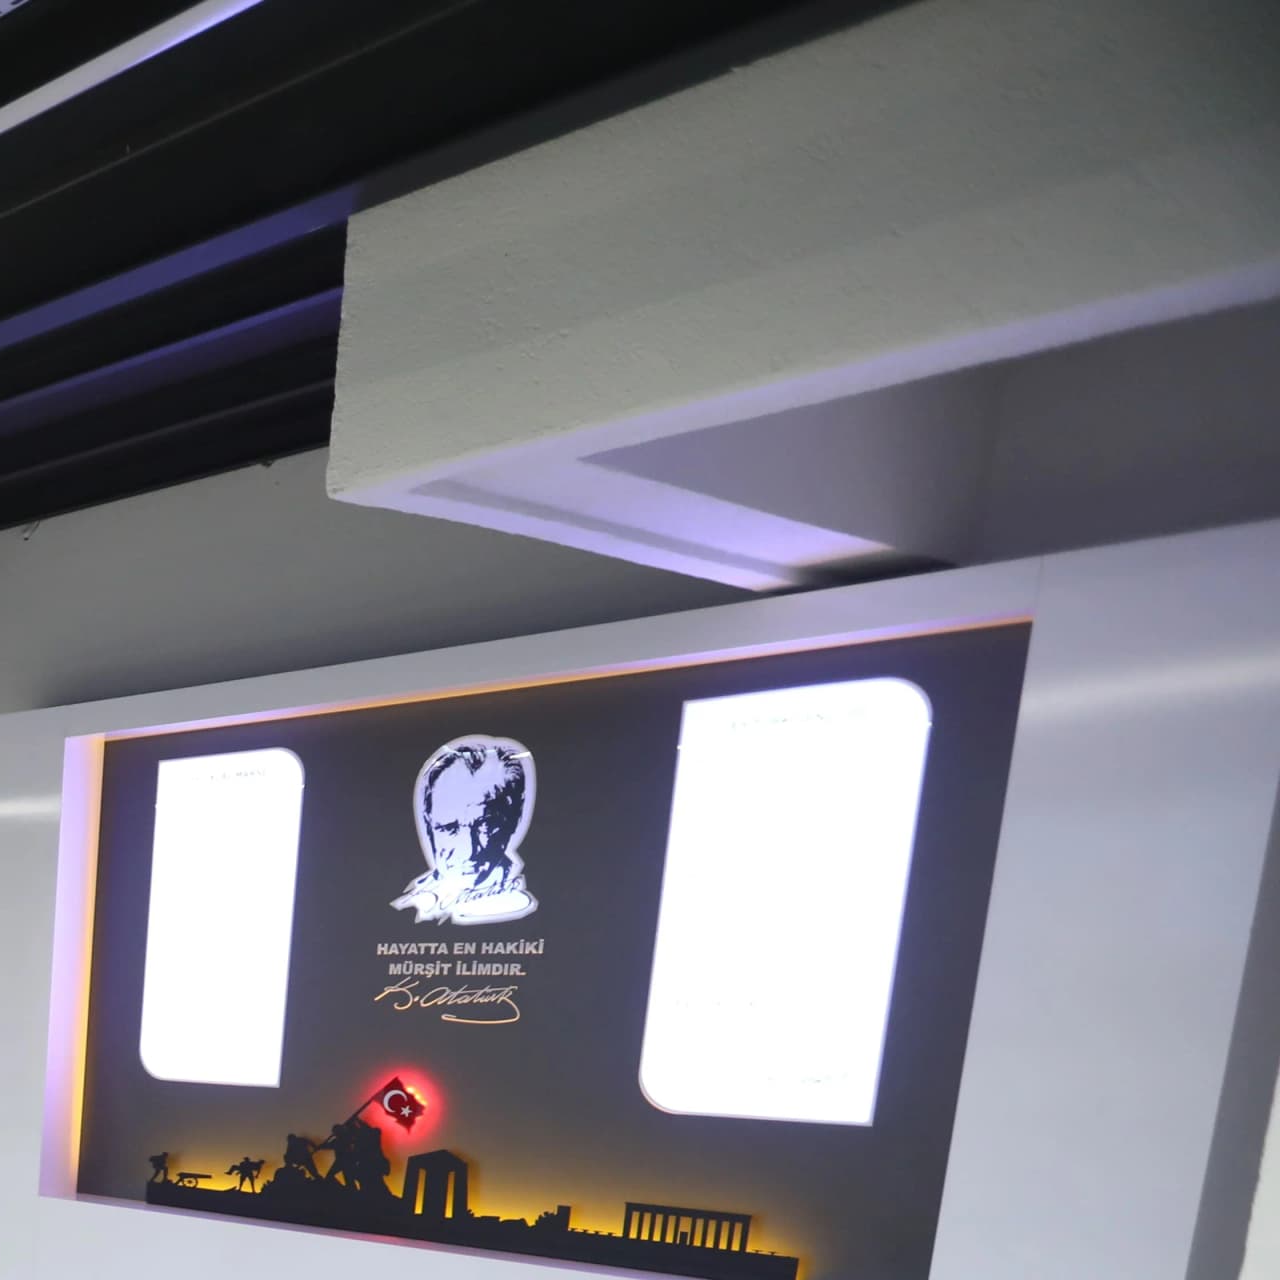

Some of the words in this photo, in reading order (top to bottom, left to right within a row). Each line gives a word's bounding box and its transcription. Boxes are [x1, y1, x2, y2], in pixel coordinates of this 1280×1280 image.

[377, 942, 449, 956] HAYATTA
[453, 942, 477, 955] EN
[481, 939, 545, 954] HAKİKİ
[389, 961, 452, 978] MÜRŞİT
